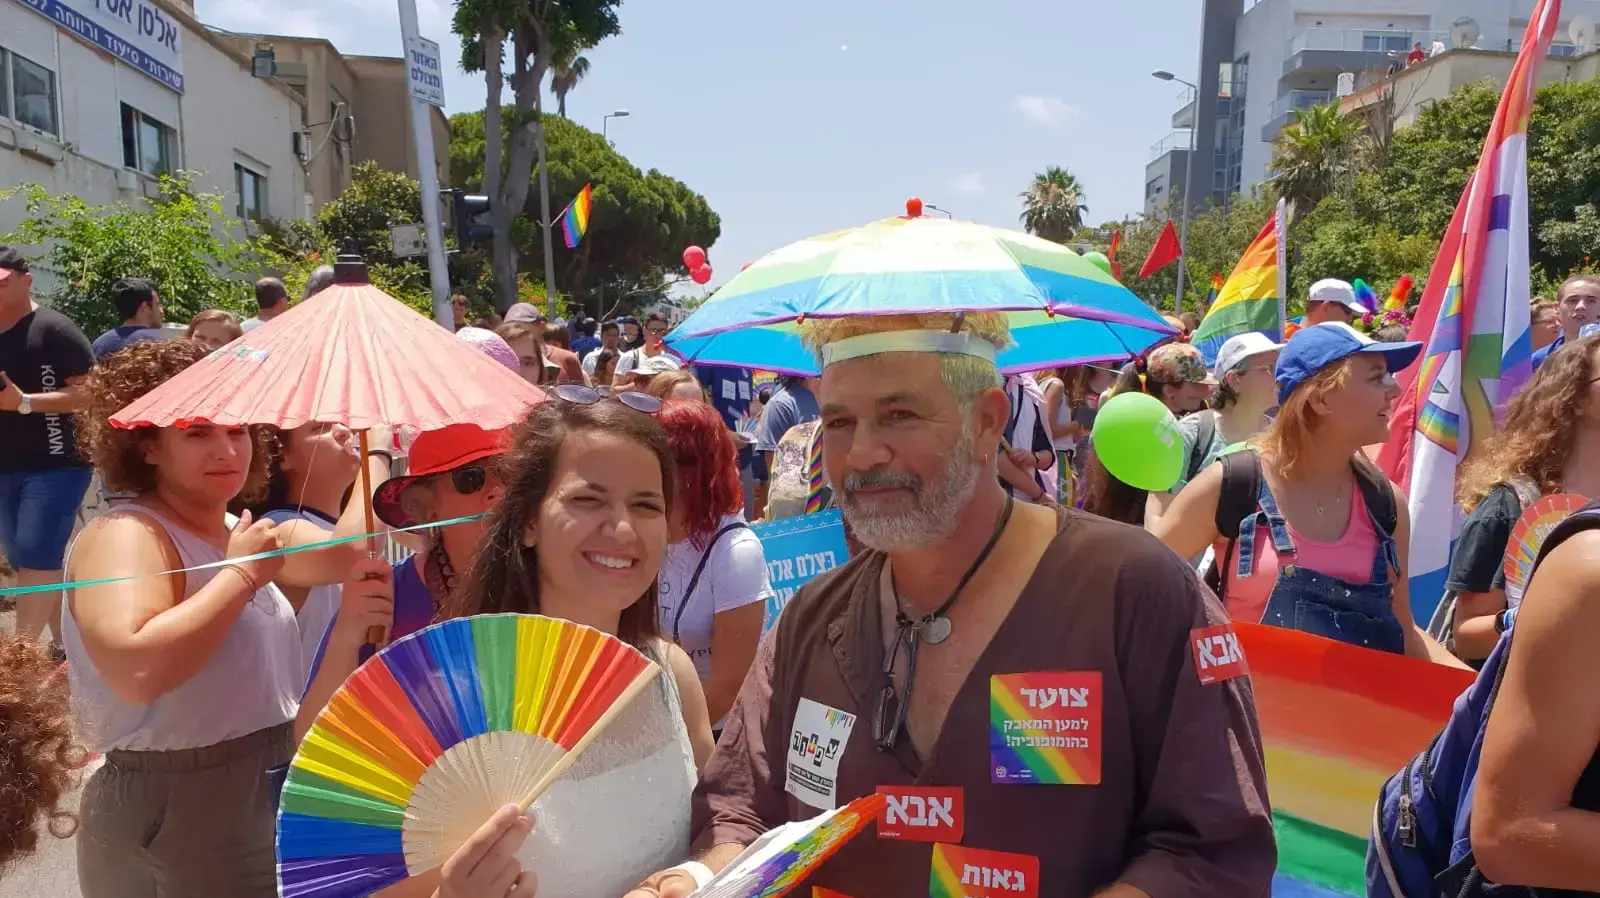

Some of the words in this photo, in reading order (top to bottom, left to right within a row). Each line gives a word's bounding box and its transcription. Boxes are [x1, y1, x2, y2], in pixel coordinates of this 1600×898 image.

[55, 5, 99, 41] ורווחה
[104, 34, 139, 64] סיעוד
[411, 49, 438, 70] האזור
[144, 57, 181, 88] שירותי
[411, 67, 440, 88] מצולם
[40, 364, 65, 455] KOBHAVN
[1196, 631, 1243, 669] אבא
[1020, 687, 1089, 709] צועד
[1003, 719, 1053, 733] המאבק
[1055, 717, 1089, 733] למען
[886, 794, 954, 828] אבא
[961, 863, 1026, 892] גאות
